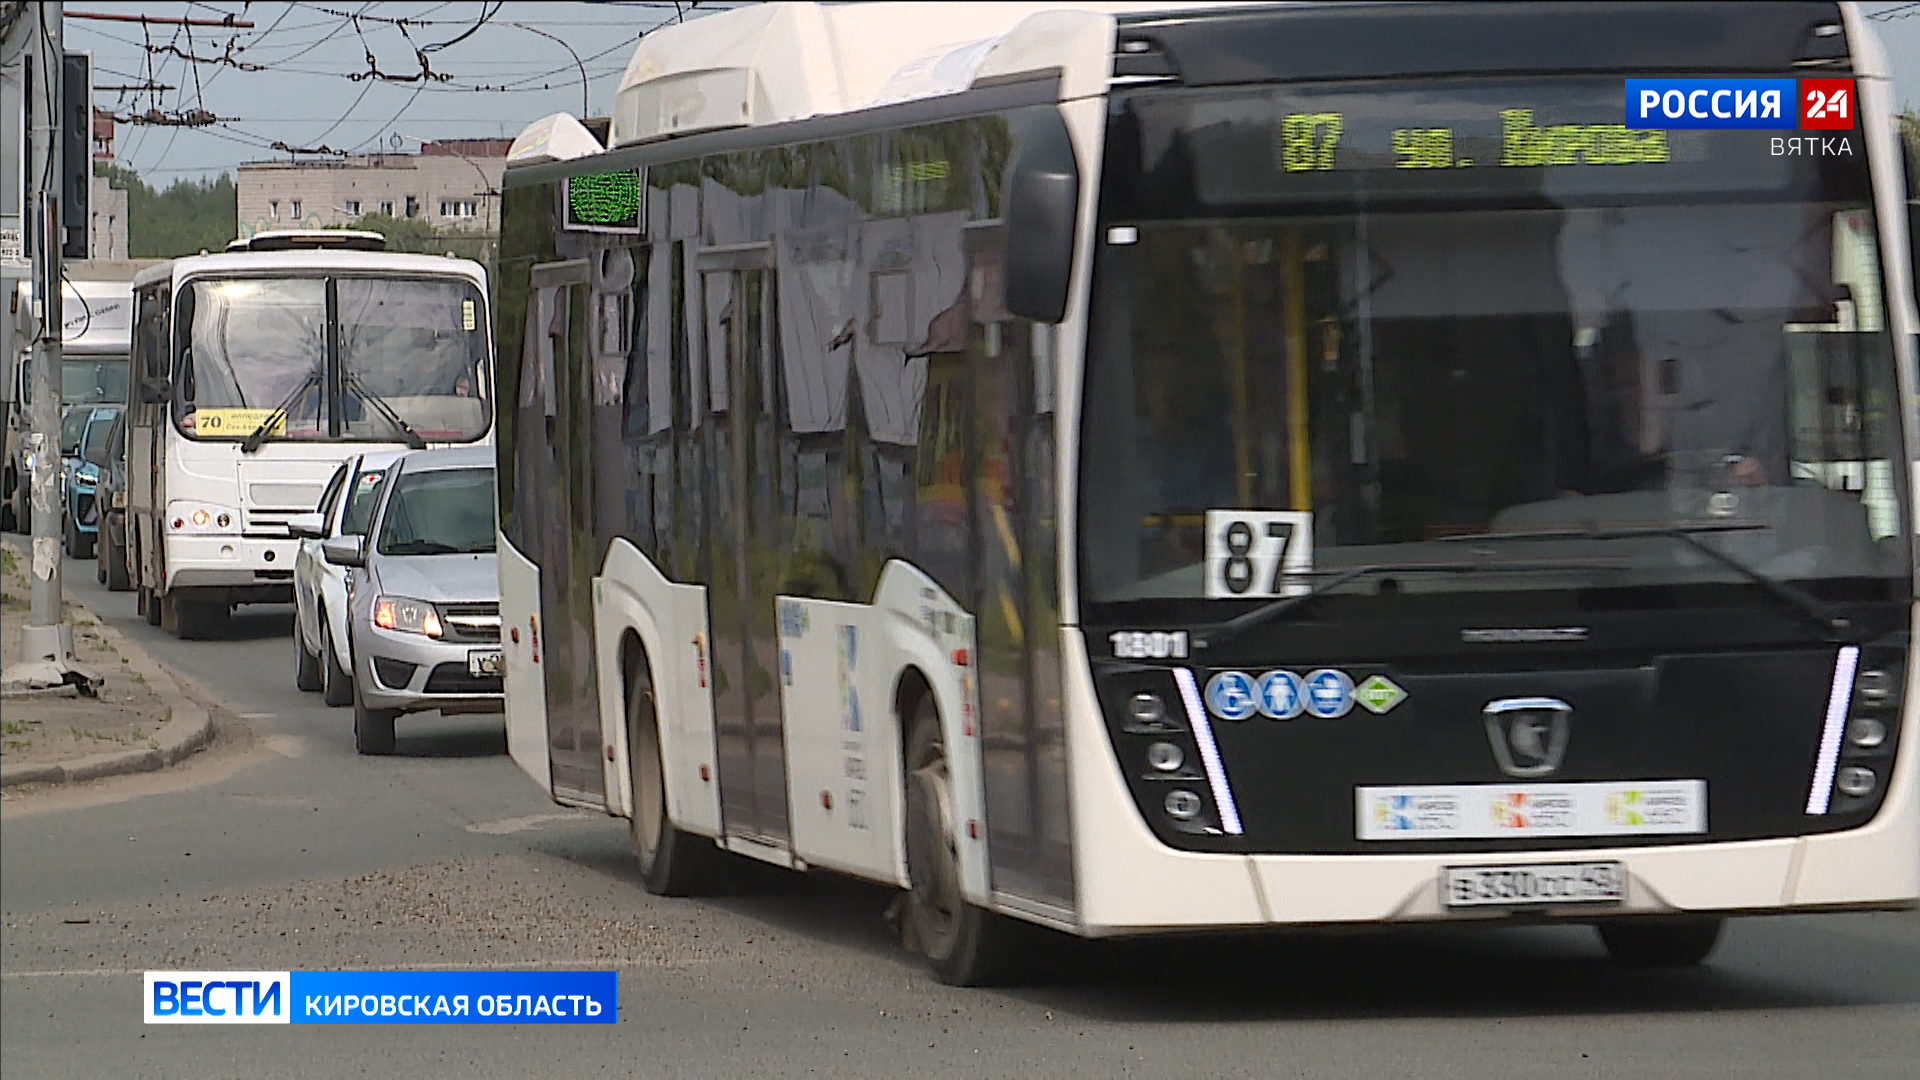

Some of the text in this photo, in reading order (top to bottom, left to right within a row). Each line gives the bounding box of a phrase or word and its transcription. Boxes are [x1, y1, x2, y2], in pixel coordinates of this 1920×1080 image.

[1281, 112, 1343, 172] 87
[200, 415, 222, 428] 70
[1225, 520, 1295, 594] 87
